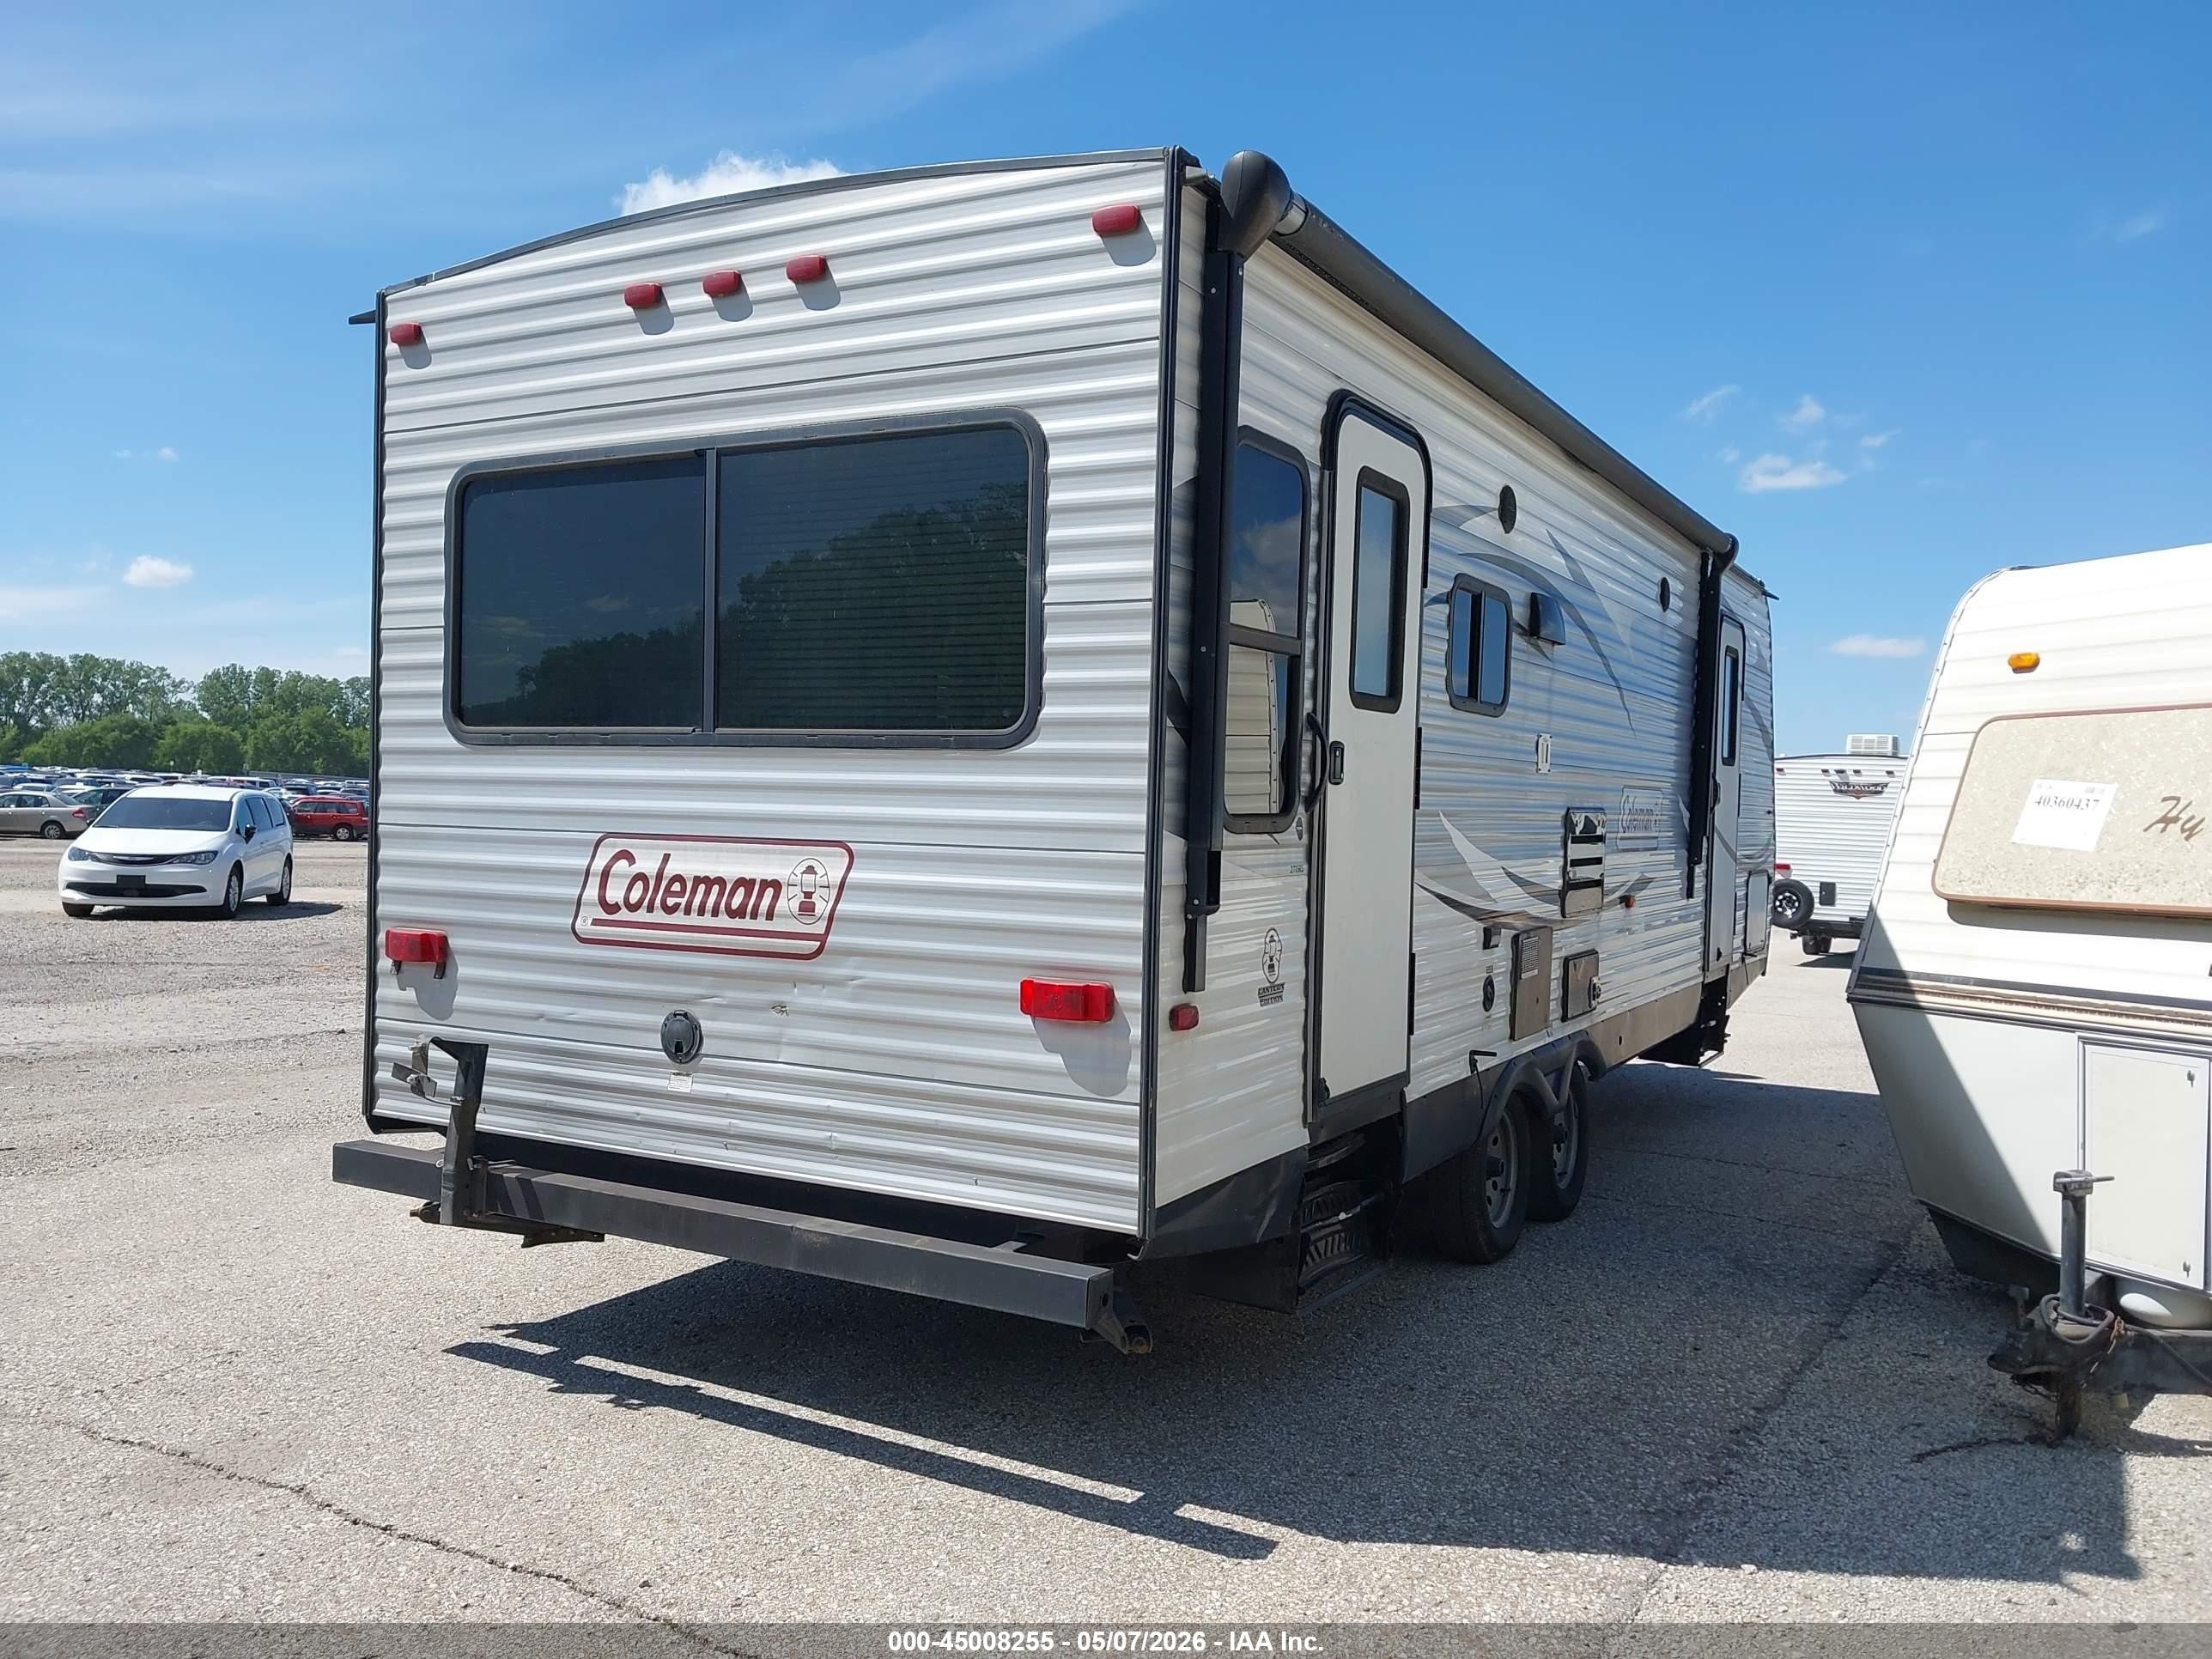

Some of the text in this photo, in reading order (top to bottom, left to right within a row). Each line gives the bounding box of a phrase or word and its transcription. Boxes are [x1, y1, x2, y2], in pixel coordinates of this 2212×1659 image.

[1620, 794, 1654, 833] Coleman
[2034, 795, 2100, 811] 40360437
[597, 848, 783, 921] Coleman
[1260, 994, 1284, 1006] EDITION
